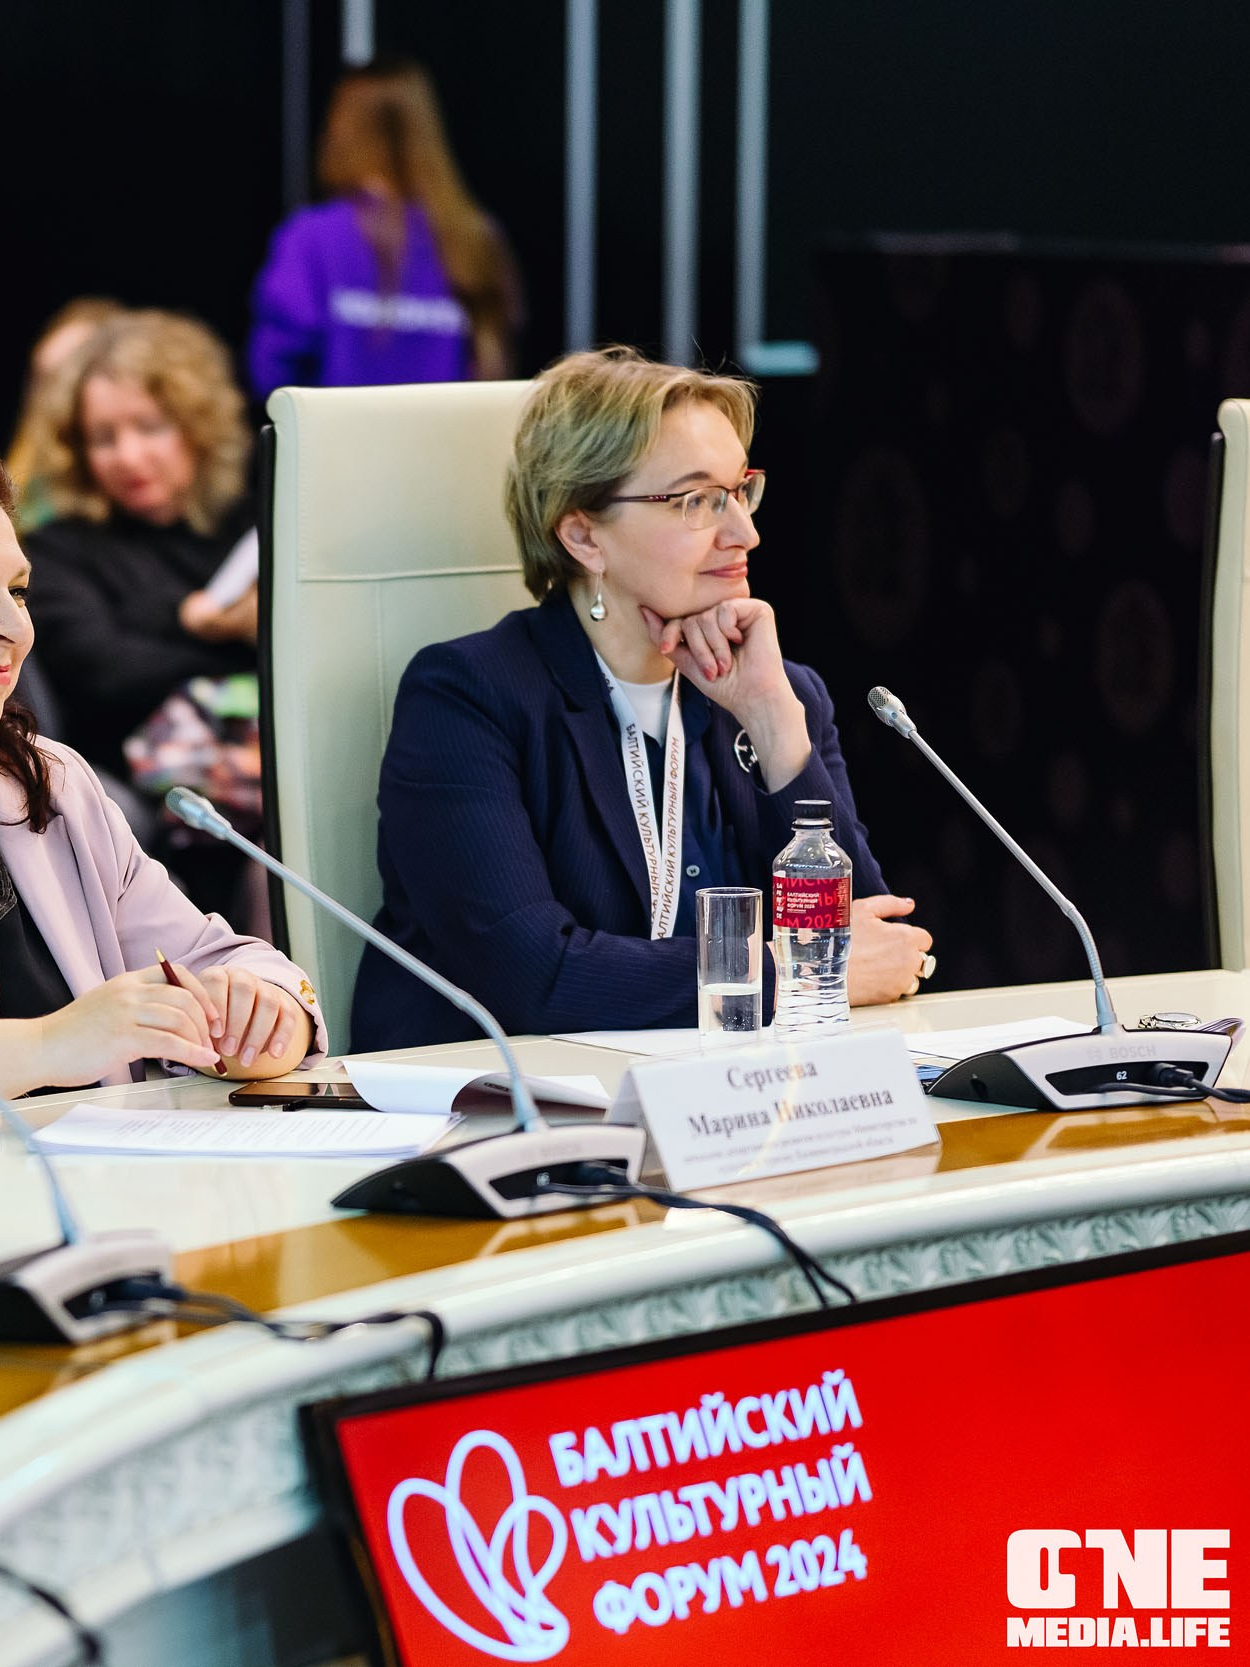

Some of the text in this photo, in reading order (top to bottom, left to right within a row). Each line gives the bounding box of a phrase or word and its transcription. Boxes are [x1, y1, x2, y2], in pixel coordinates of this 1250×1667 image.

[626, 723, 647, 809] БАЛТИЙСКИЙ
[670, 736, 679, 780] ФОРУМ
[667, 781, 678, 858] КУЛЬТУРНЫЙ
[727, 1060, 818, 1092] Сергеева
[1110, 1045, 1156, 1059] BOSCH
[1116, 1071, 1127, 1080] 62
[687, 1109, 772, 1139] Марина
[774, 1089, 894, 1124] Николаевна
[549, 1369, 862, 1488] БАЛТИЙСКИЙ
[570, 1442, 872, 1562] КУЛЬТУРНЫЙ
[593, 1528, 867, 1634] ФОРУМ 2024
